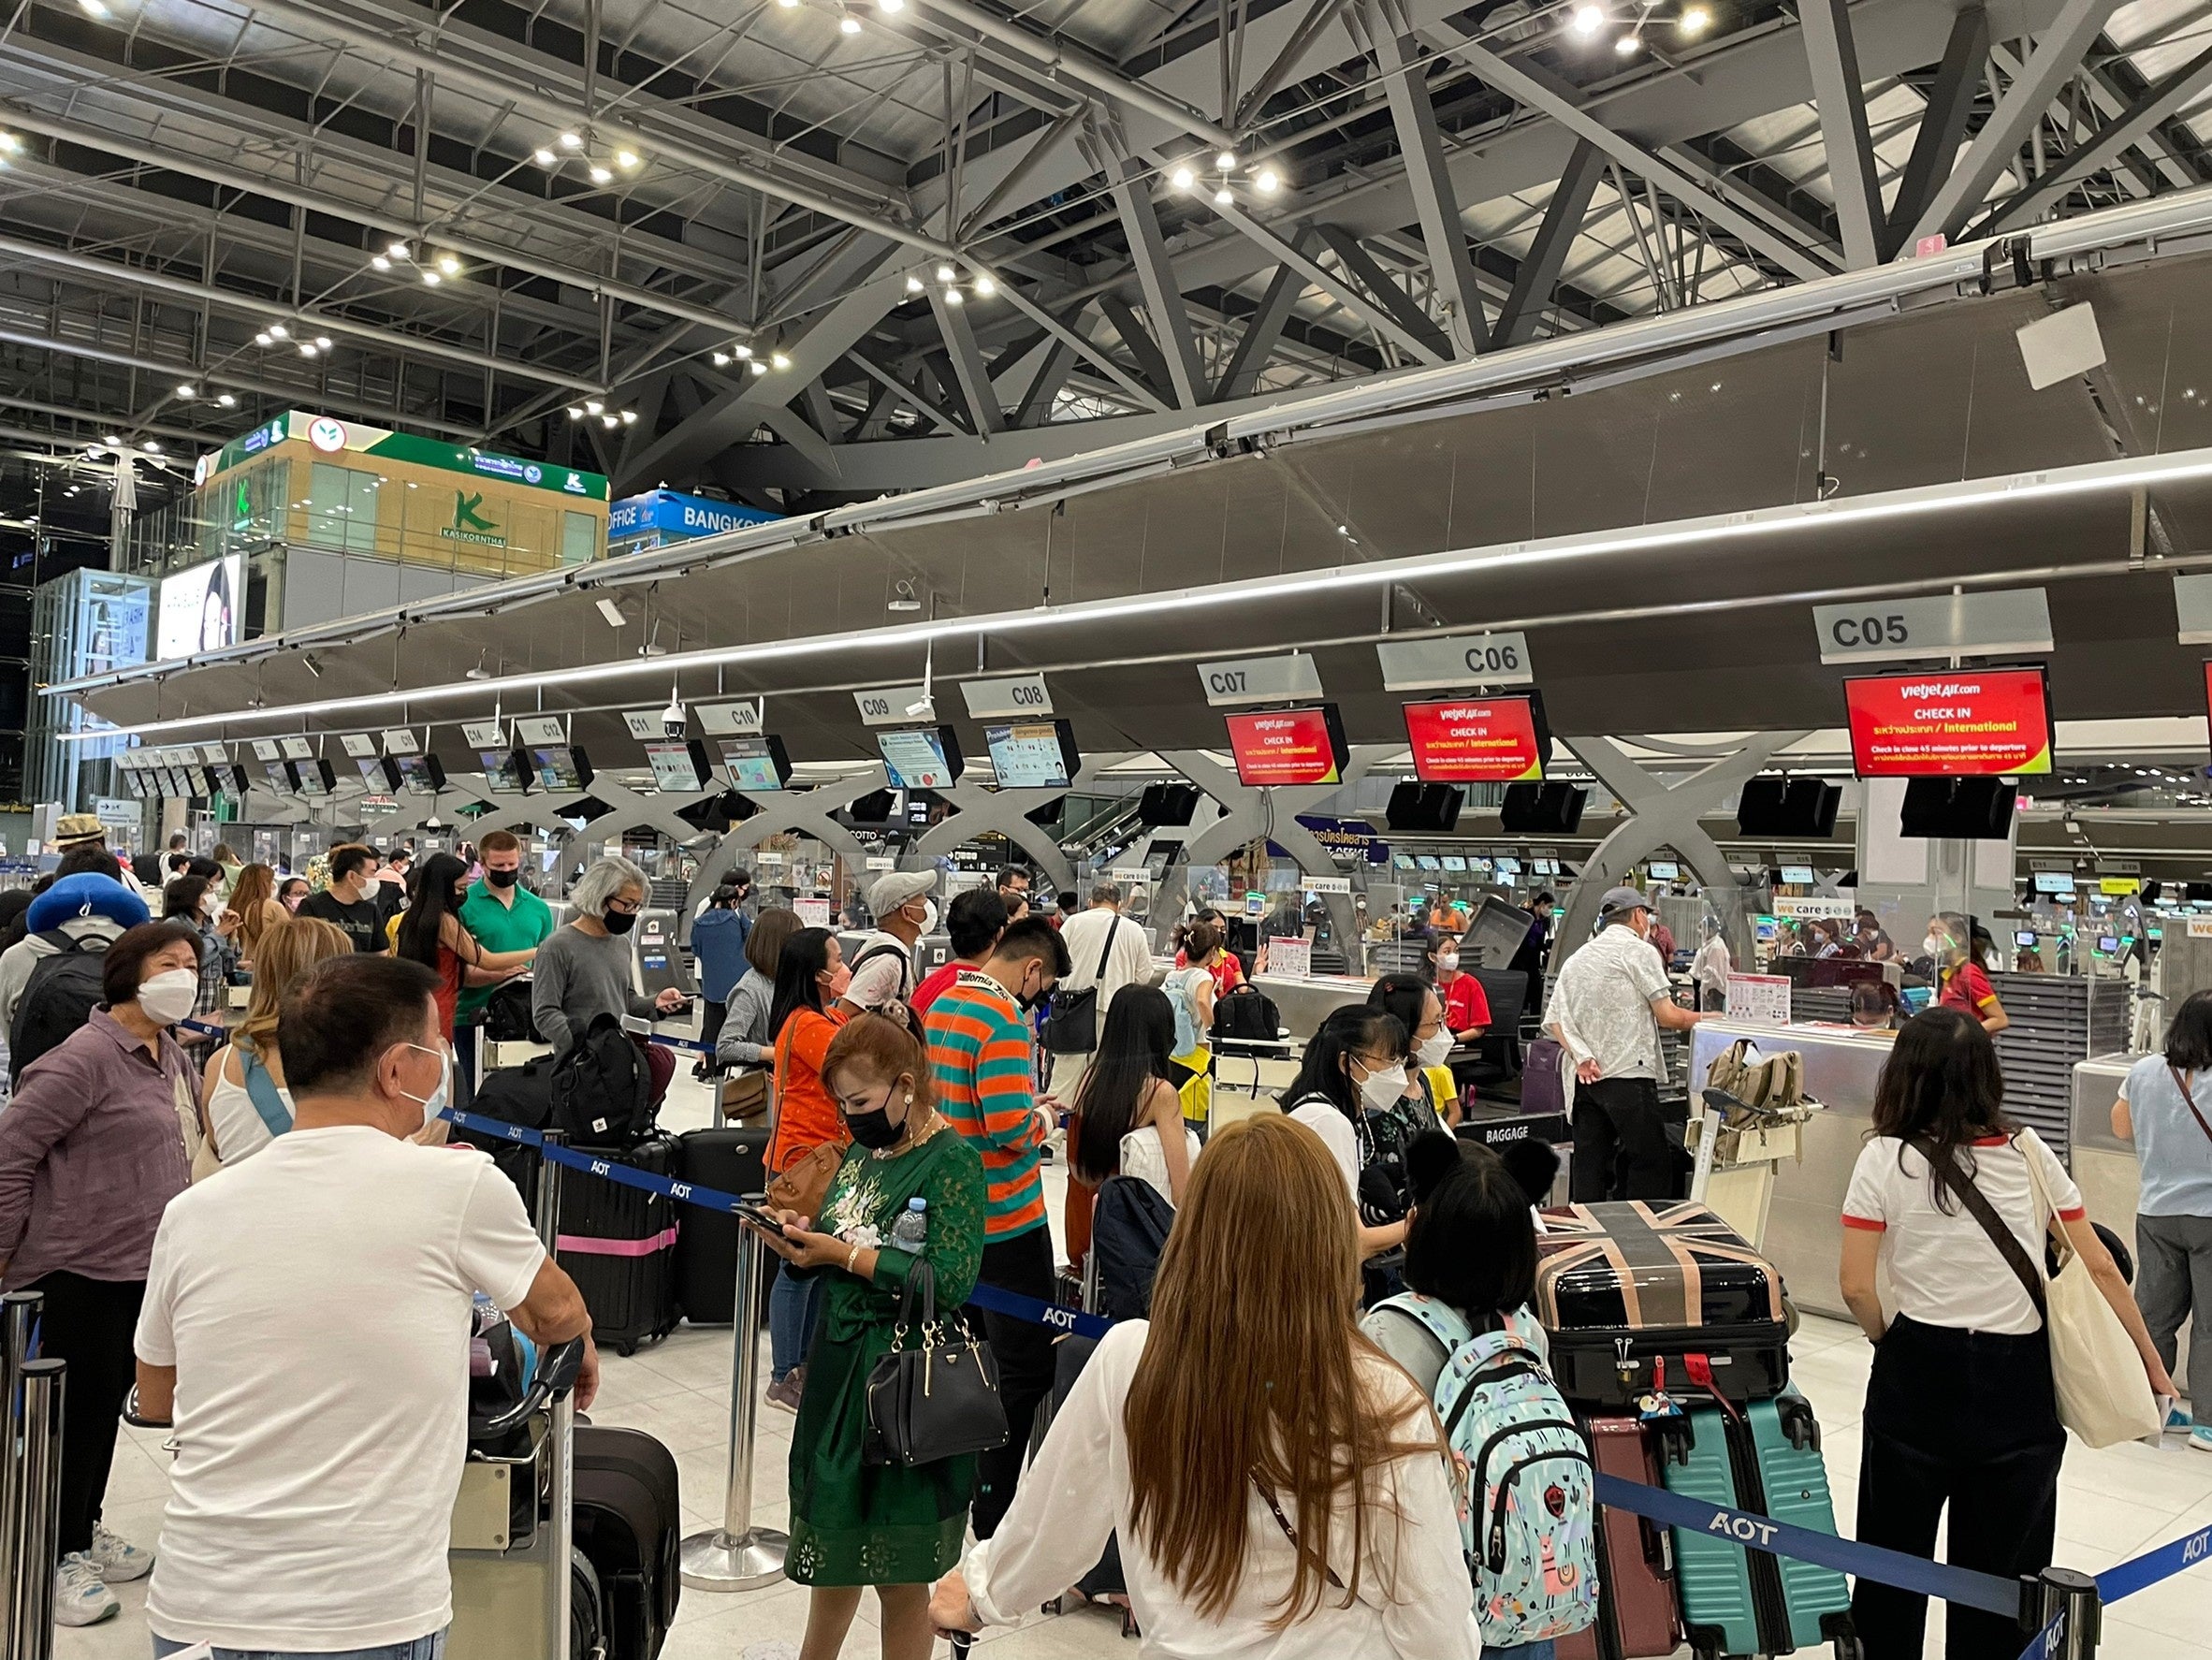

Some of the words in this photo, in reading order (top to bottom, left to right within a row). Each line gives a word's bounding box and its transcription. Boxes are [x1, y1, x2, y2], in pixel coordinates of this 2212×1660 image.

[685, 506, 765, 532] BANGK
[1832, 615, 1908, 647] C05
[1465, 646, 1519, 672] C06
[1210, 672, 1245, 693] C07
[1012, 686, 1043, 705] C08
[863, 698, 889, 716] C09
[1914, 708, 1955, 720] CHECK
[1957, 707, 1971, 718] IN
[630, 718, 650, 732] C11
[732, 710, 755, 725] C10
[543, 724, 561, 737] C12
[1450, 728, 1477, 736] CHECK
[1478, 727, 1487, 736] IN
[1944, 721, 2016, 734] International
[468, 730, 483, 742] C14
[1471, 738, 1518, 748] International
[1960, 744, 1978, 754] prior
[1989, 744, 2027, 753] departure
[1778, 905, 1794, 913] we
[1797, 906, 1822, 914] care
[453, 1111, 467, 1124] AOT
[507, 1126, 524, 1139] AOT
[1486, 1126, 1529, 1143] BAGGAGE
[591, 1160, 610, 1176] AOT
[671, 1183, 691, 1200] AOT
[1042, 1307, 1077, 1329] AOT
[1709, 1512, 1779, 1546] AOT
[2183, 1531, 2211, 1564] AOT
[2045, 1611, 2066, 1659] AOT
